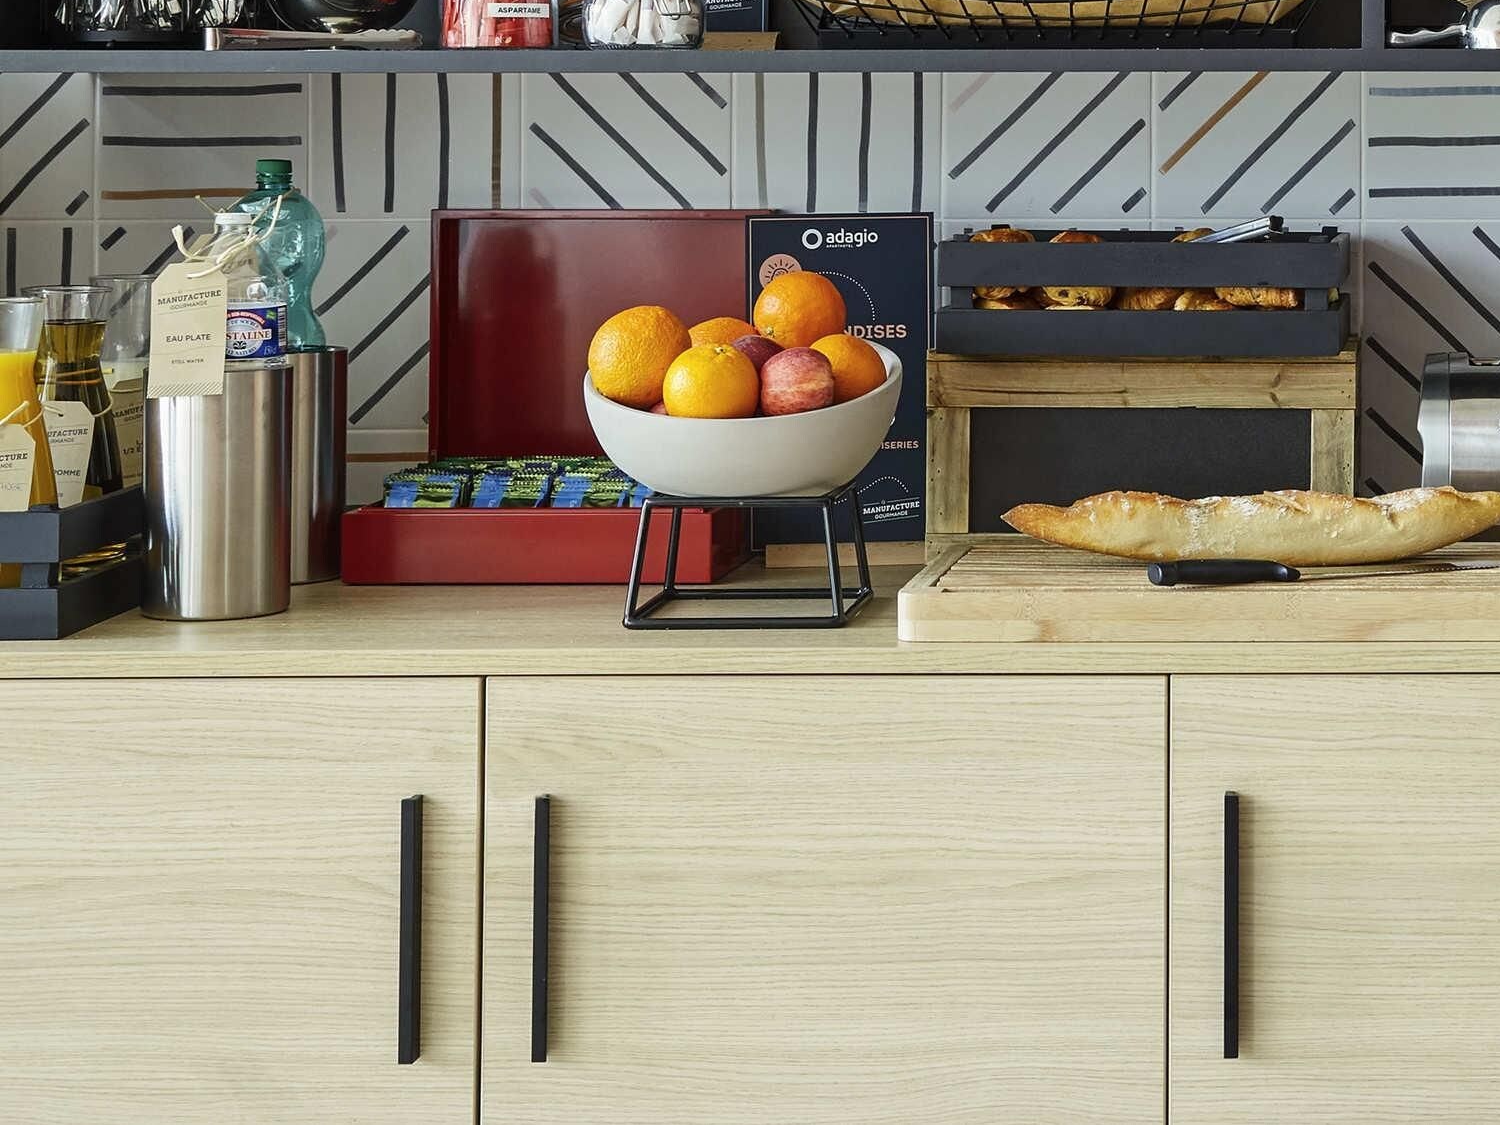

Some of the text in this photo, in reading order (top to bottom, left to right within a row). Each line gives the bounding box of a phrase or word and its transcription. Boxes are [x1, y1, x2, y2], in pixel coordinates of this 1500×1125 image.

[826, 228, 879, 247] adagio
[158, 290, 222, 306] MANUFACTURE
[166, 333, 212, 343] EAU PLATE
[226, 330, 271, 340] STALINE
[47, 428, 89, 438] UFACTURE
[881, 440, 919, 449] ISERIES
[863, 501, 920, 515] MANUFACTURE
